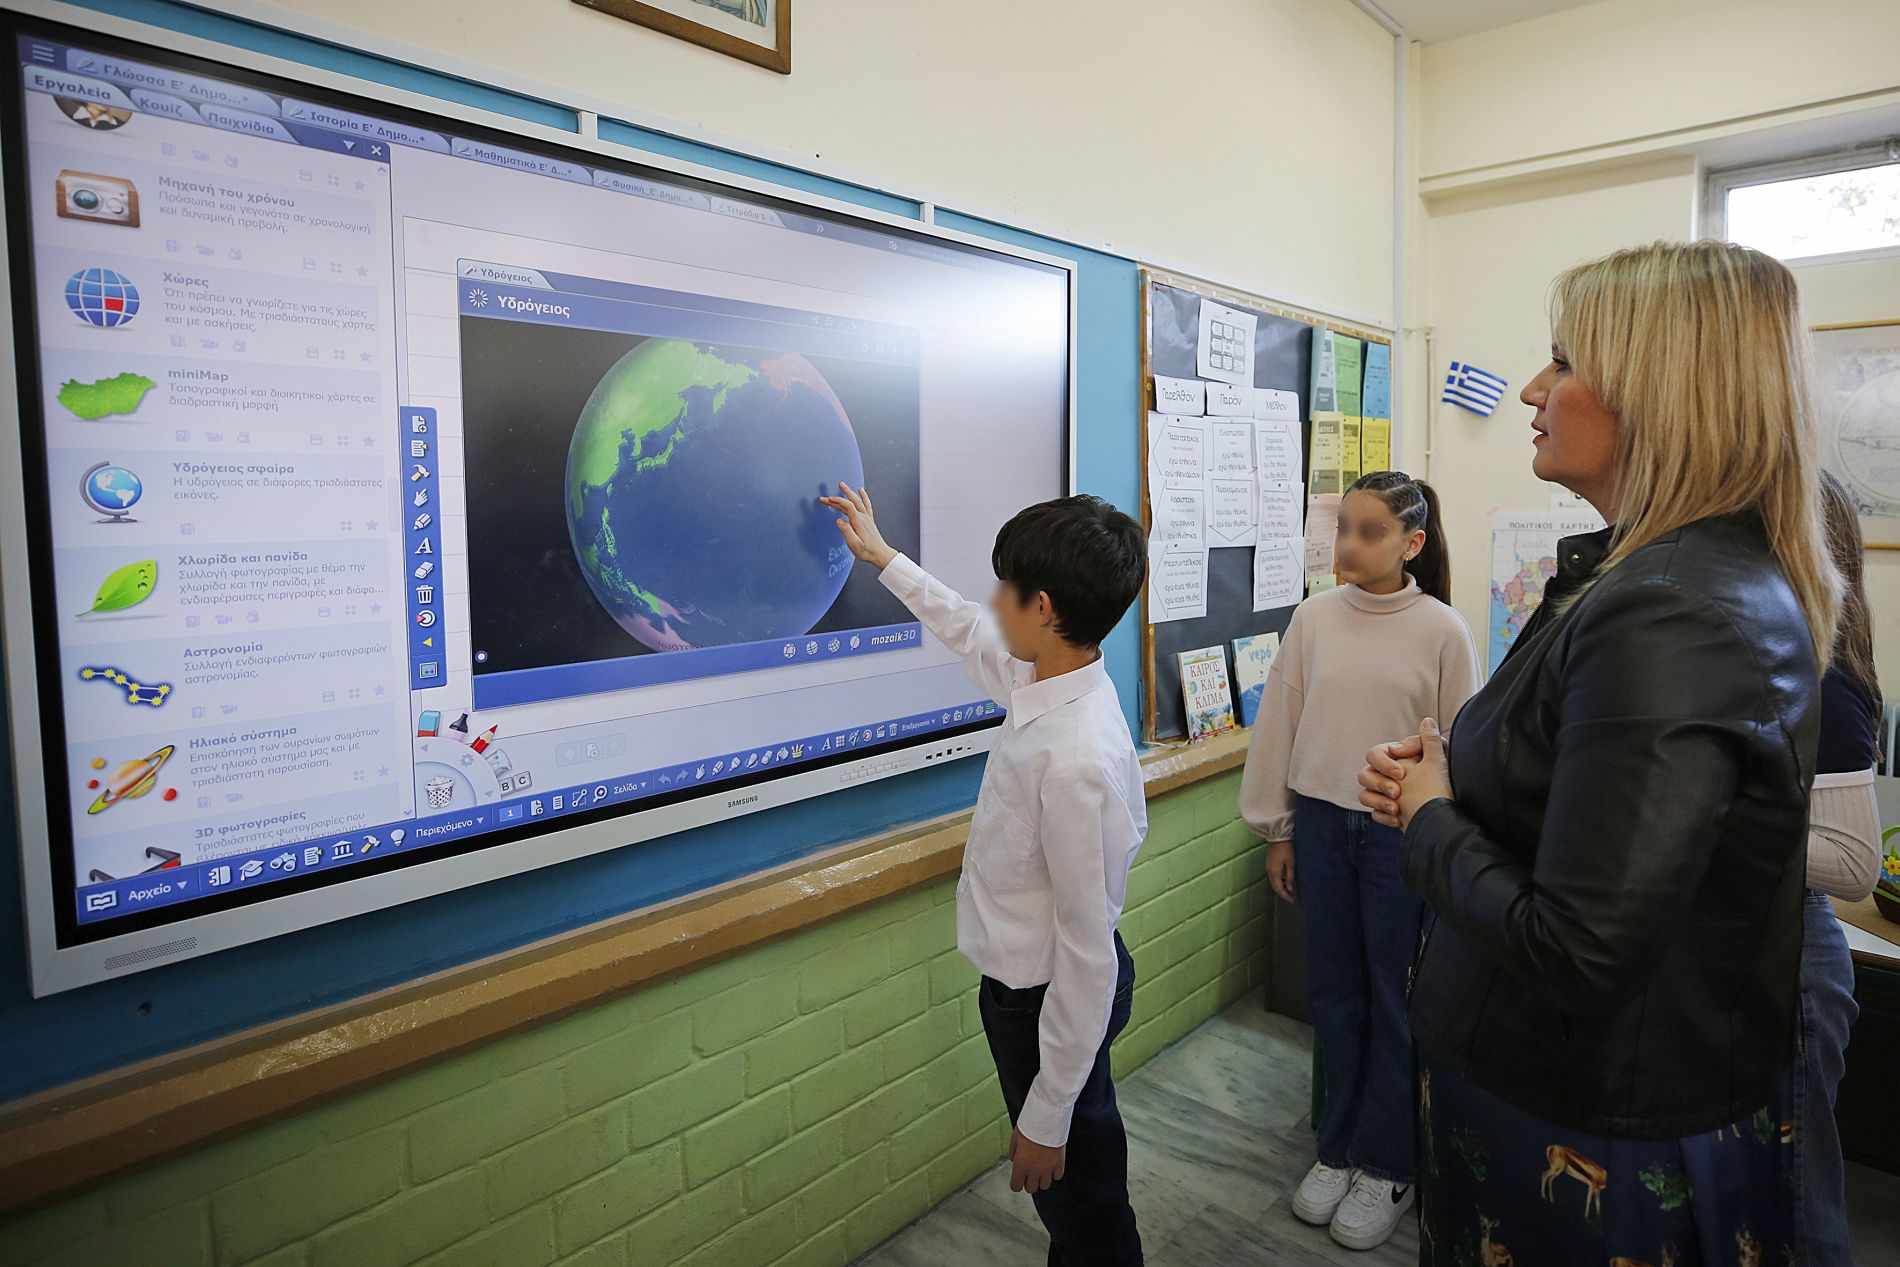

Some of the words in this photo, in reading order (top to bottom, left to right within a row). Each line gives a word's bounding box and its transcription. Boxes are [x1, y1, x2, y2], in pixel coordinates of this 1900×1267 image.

[103, 63, 166, 87] Γλώσσα
[34, 74, 111, 100] Εργαλεία
[139, 97, 183, 117] Κουίζ
[208, 112, 275, 134] Παιχνίδια
[310, 111, 358, 131] Ιστορία
[475, 148, 536, 170] Μαθηματικά
[159, 176, 216, 197] Μηχανή
[219, 187, 244, 200] του
[247, 192, 296, 208] χρόνου
[159, 190, 216, 209] Πρόσωπα
[219, 201, 236, 211] και
[239, 205, 291, 221] γεγονότα
[293, 213, 306, 223] σε
[309, 216, 371, 236] χρονολογική
[159, 205, 177, 216] και
[181, 205, 235, 226] δυναμική
[238, 217, 289, 234] προβολή.
[162, 271, 210, 289] Χώρες
[480, 267, 533, 284] Υδρόγειος
[163, 286, 185, 298] Ότι
[188, 290, 225, 303] πρέπει
[229, 295, 243, 304] να
[246, 297, 299, 312] γνωρίζετε
[301, 303, 317, 313] για
[319, 304, 334, 313] τις
[336, 305, 367, 319] χώρες
[497, 295, 571, 319] Υδρόγειος
[163, 302, 186, 311] του
[189, 303, 237, 319] κόσμου.
[240, 309, 257, 319] Με
[260, 310, 340, 328] τρισδιάστατους
[342, 319, 376, 332] χάρτες
[164, 316, 183, 324] και
[186, 318, 201, 327] με
[203, 317, 258, 333] ασκήσεις.
[168, 369, 230, 384] miniMap
[168, 382, 248, 397] Τοπογραφικοί
[251, 389, 268, 398] και
[270, 388, 325, 402] διοικητικοί
[327, 391, 362, 404] χάρτες
[363, 394, 377, 404] σε
[168, 397, 240, 411] διαδραστική
[242, 400, 280, 413] μορφή
[172, 461, 245, 476] Υδρόγειος
[246, 464, 296, 476] σφαίρα
[173, 477, 183, 487] Η
[186, 478, 244, 489] υδρόγειος
[246, 479, 261, 487] σε
[262, 478, 313, 489] διάφορες
[314, 478, 383, 489] τρισδιάστατες
[173, 489, 219, 502] εικόνες.
[178, 554, 238, 567] Χλωρίδα
[240, 554, 262, 563] και
[265, 551, 309, 562] πανίδα
[179, 567, 228, 581] Συλλογή
[230, 564, 304, 579] φωτογραφίας
[305, 565, 319, 575] με
[321, 563, 346, 574] θέμα
[348, 563, 366, 573] την
[179, 581, 227, 594] χλωρίδα
[230, 580, 246, 589] και
[250, 579, 269, 589] την
[272, 576, 311, 588] πανίδα,
[313, 577, 327, 587] με
[179, 593, 265, 606] ενδιαφέρουσες
[267, 587, 327, 601] περιγραφές
[329, 587, 344, 597] και
[871, 629, 916, 646] mozaik3D
[183, 641, 264, 659] Αστρονομία
[183, 658, 233, 672] Συλλογή
[235, 652, 316, 667] ενδιαφερόντων
[319, 643, 387, 660] φωτογραφιών
[184, 669, 258, 685] αστρονομίας.
[1190, 660, 1220, 678] ΚΑΙΡΟΣ
[1200, 677, 1216, 691] ΚΑΙ
[1195, 691, 1224, 709] ΚΛΙΜΑ
[189, 734, 237, 749] Ηλιακό
[240, 728, 297, 743] σύστημα
[190, 745, 257, 763] Επισκόπηση
[260, 742, 281, 752] των
[283, 735, 332, 750] ουρανίων
[334, 728, 380, 743] σωμάτων
[190, 764, 218, 776] στον
[221, 757, 258, 772] ηλιακό
[260, 751, 307, 765] σύστημα
[310, 748, 329, 759] μας
[331, 744, 346, 754] και
[348, 742, 361, 753] με
[192, 770, 265, 789] τρισδιάστατη
[267, 758, 332, 778] παρουσίαση.
[613, 783, 638, 795] Σελίδα
[727, 795, 759, 809] SAMSUNG
[194, 827, 215, 839] 3D
[217, 810, 307, 835] φωτογραφίες
[195, 832, 274, 852] Τρισδιάστατες
[277, 817, 344, 836] φωτογραφίες
[346, 812, 365, 822] που
[415, 819, 473, 839] Περιεχόμενο
[127, 883, 172, 902] Αρχείο
